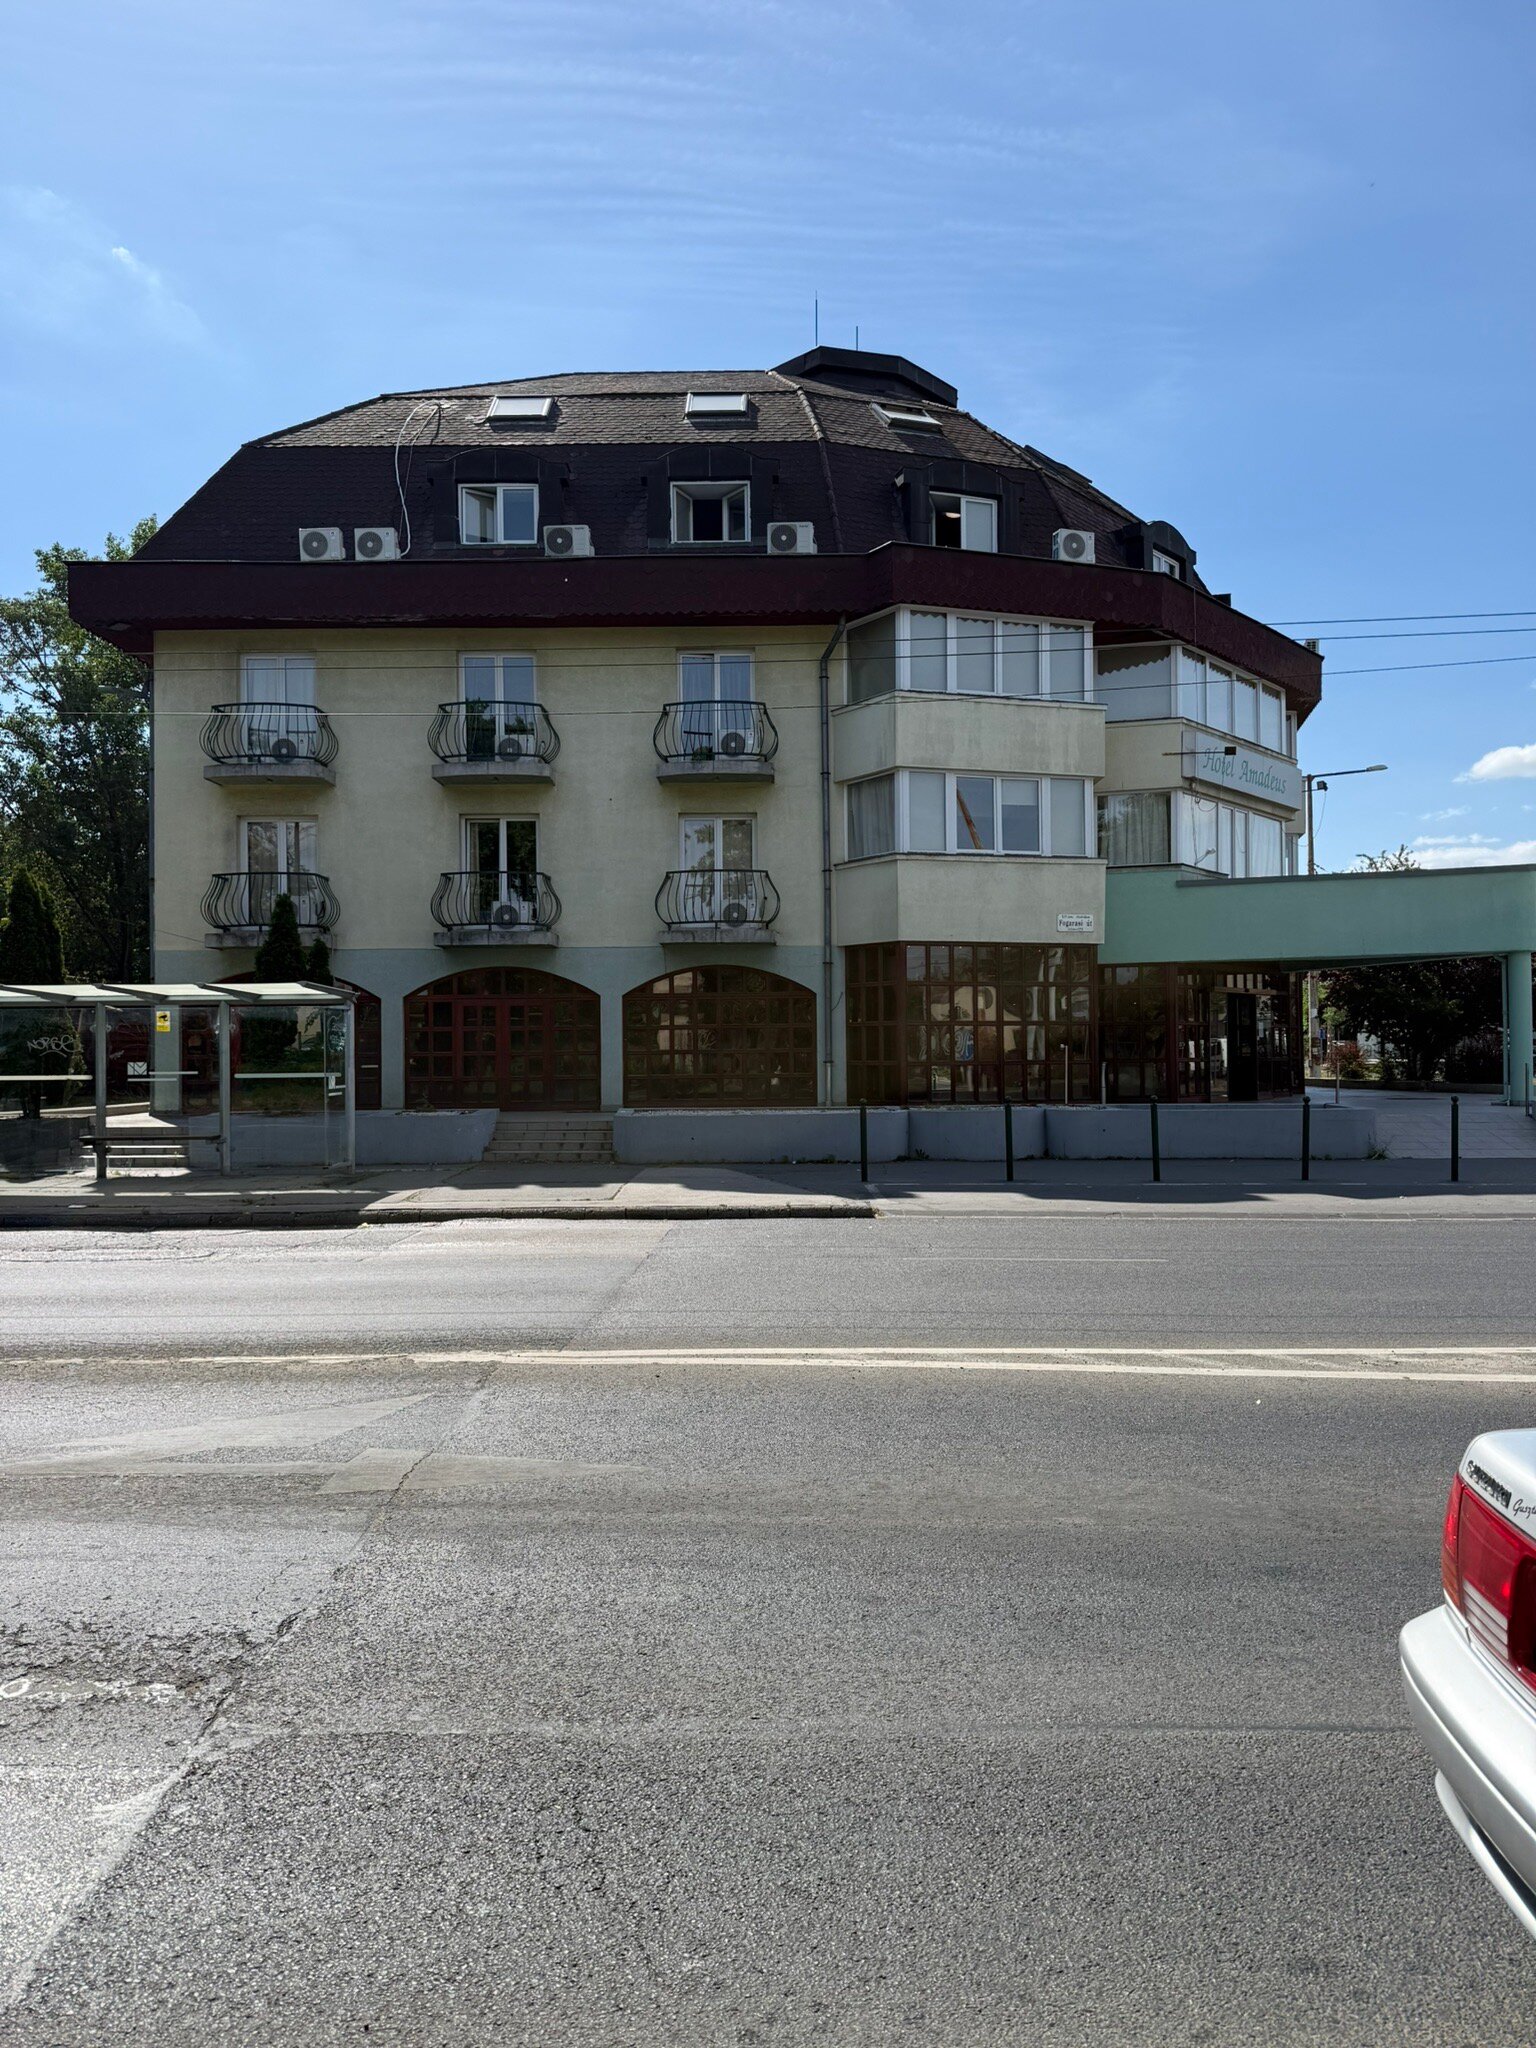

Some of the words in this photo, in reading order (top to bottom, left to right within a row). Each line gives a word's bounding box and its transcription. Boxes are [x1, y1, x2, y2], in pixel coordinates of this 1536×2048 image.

[1203, 747, 1235, 777] Hotel
[1240, 760, 1287, 794] Amadeus
[1059, 919, 1084, 927] Fogarasi
